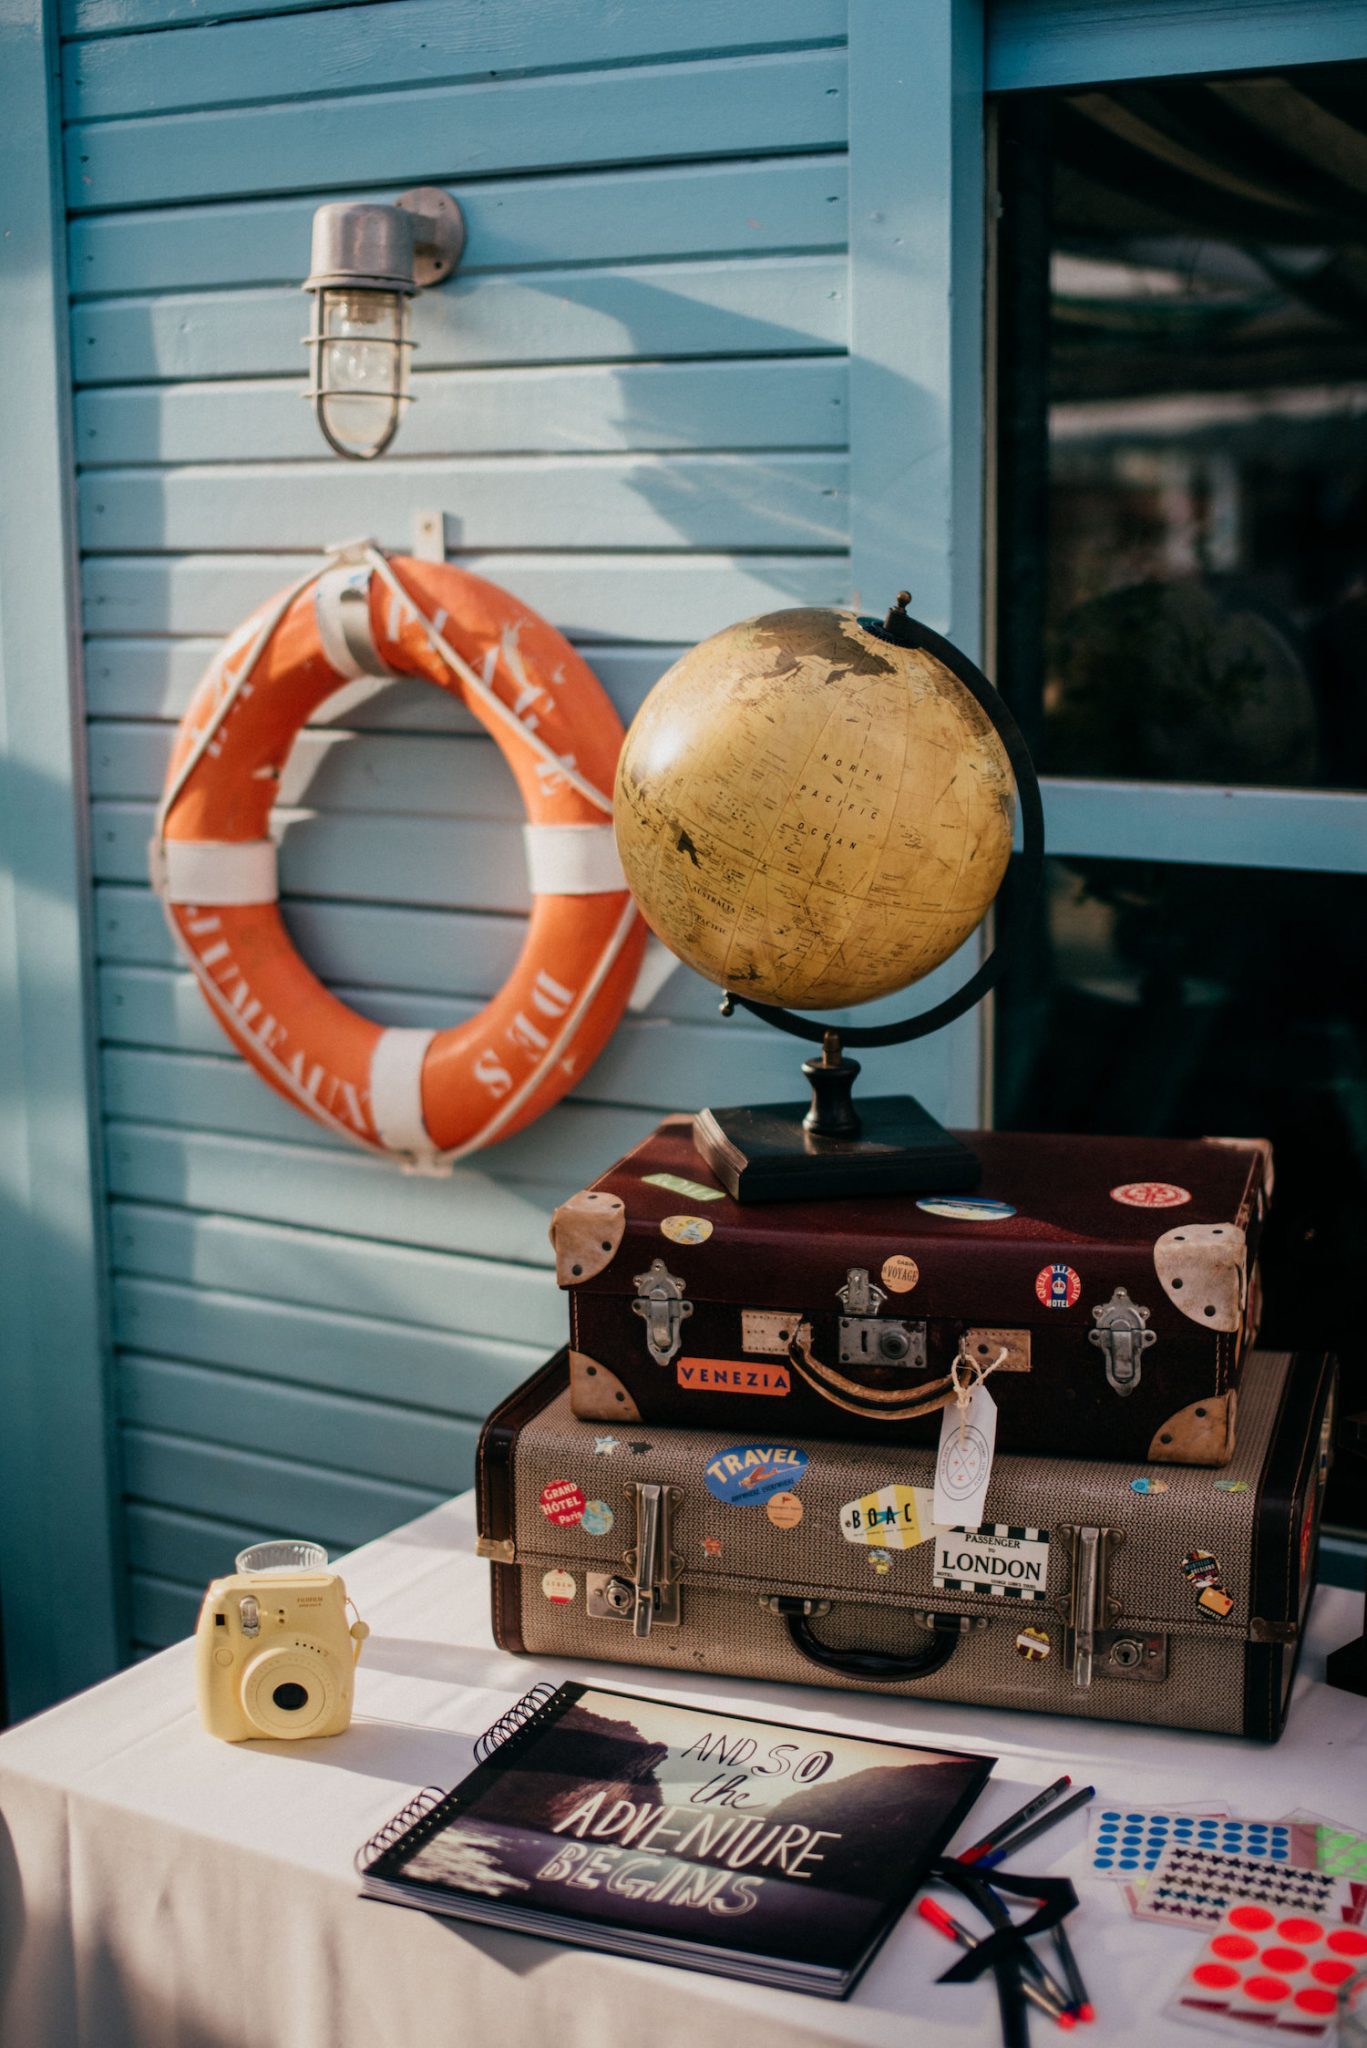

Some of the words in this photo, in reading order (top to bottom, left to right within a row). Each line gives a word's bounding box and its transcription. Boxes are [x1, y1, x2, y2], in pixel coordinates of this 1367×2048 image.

[822, 753, 882, 781] NORTH
[799, 784, 878, 820] PACIFIC
[797, 822, 857, 850] OCEAN
[692, 886, 736, 914] AUSTRALIA
[1046, 1299, 1070, 1308] HOTEL
[681, 1367, 788, 1389] VENEZIA
[706, 1448, 801, 1484] TRAVEL
[543, 1482, 578, 1500] GRAND
[852, 1503, 912, 1529] BOAC
[965, 1533, 1021, 1549] PASSENGER
[942, 1550, 1042, 1581] LONDON
[681, 1732, 758, 1768] AND
[751, 1744, 835, 1783] SO
[689, 1773, 769, 1810] the
[552, 1791, 842, 1878] ADVENTURE
[536, 1841, 766, 1917] BEGINS
